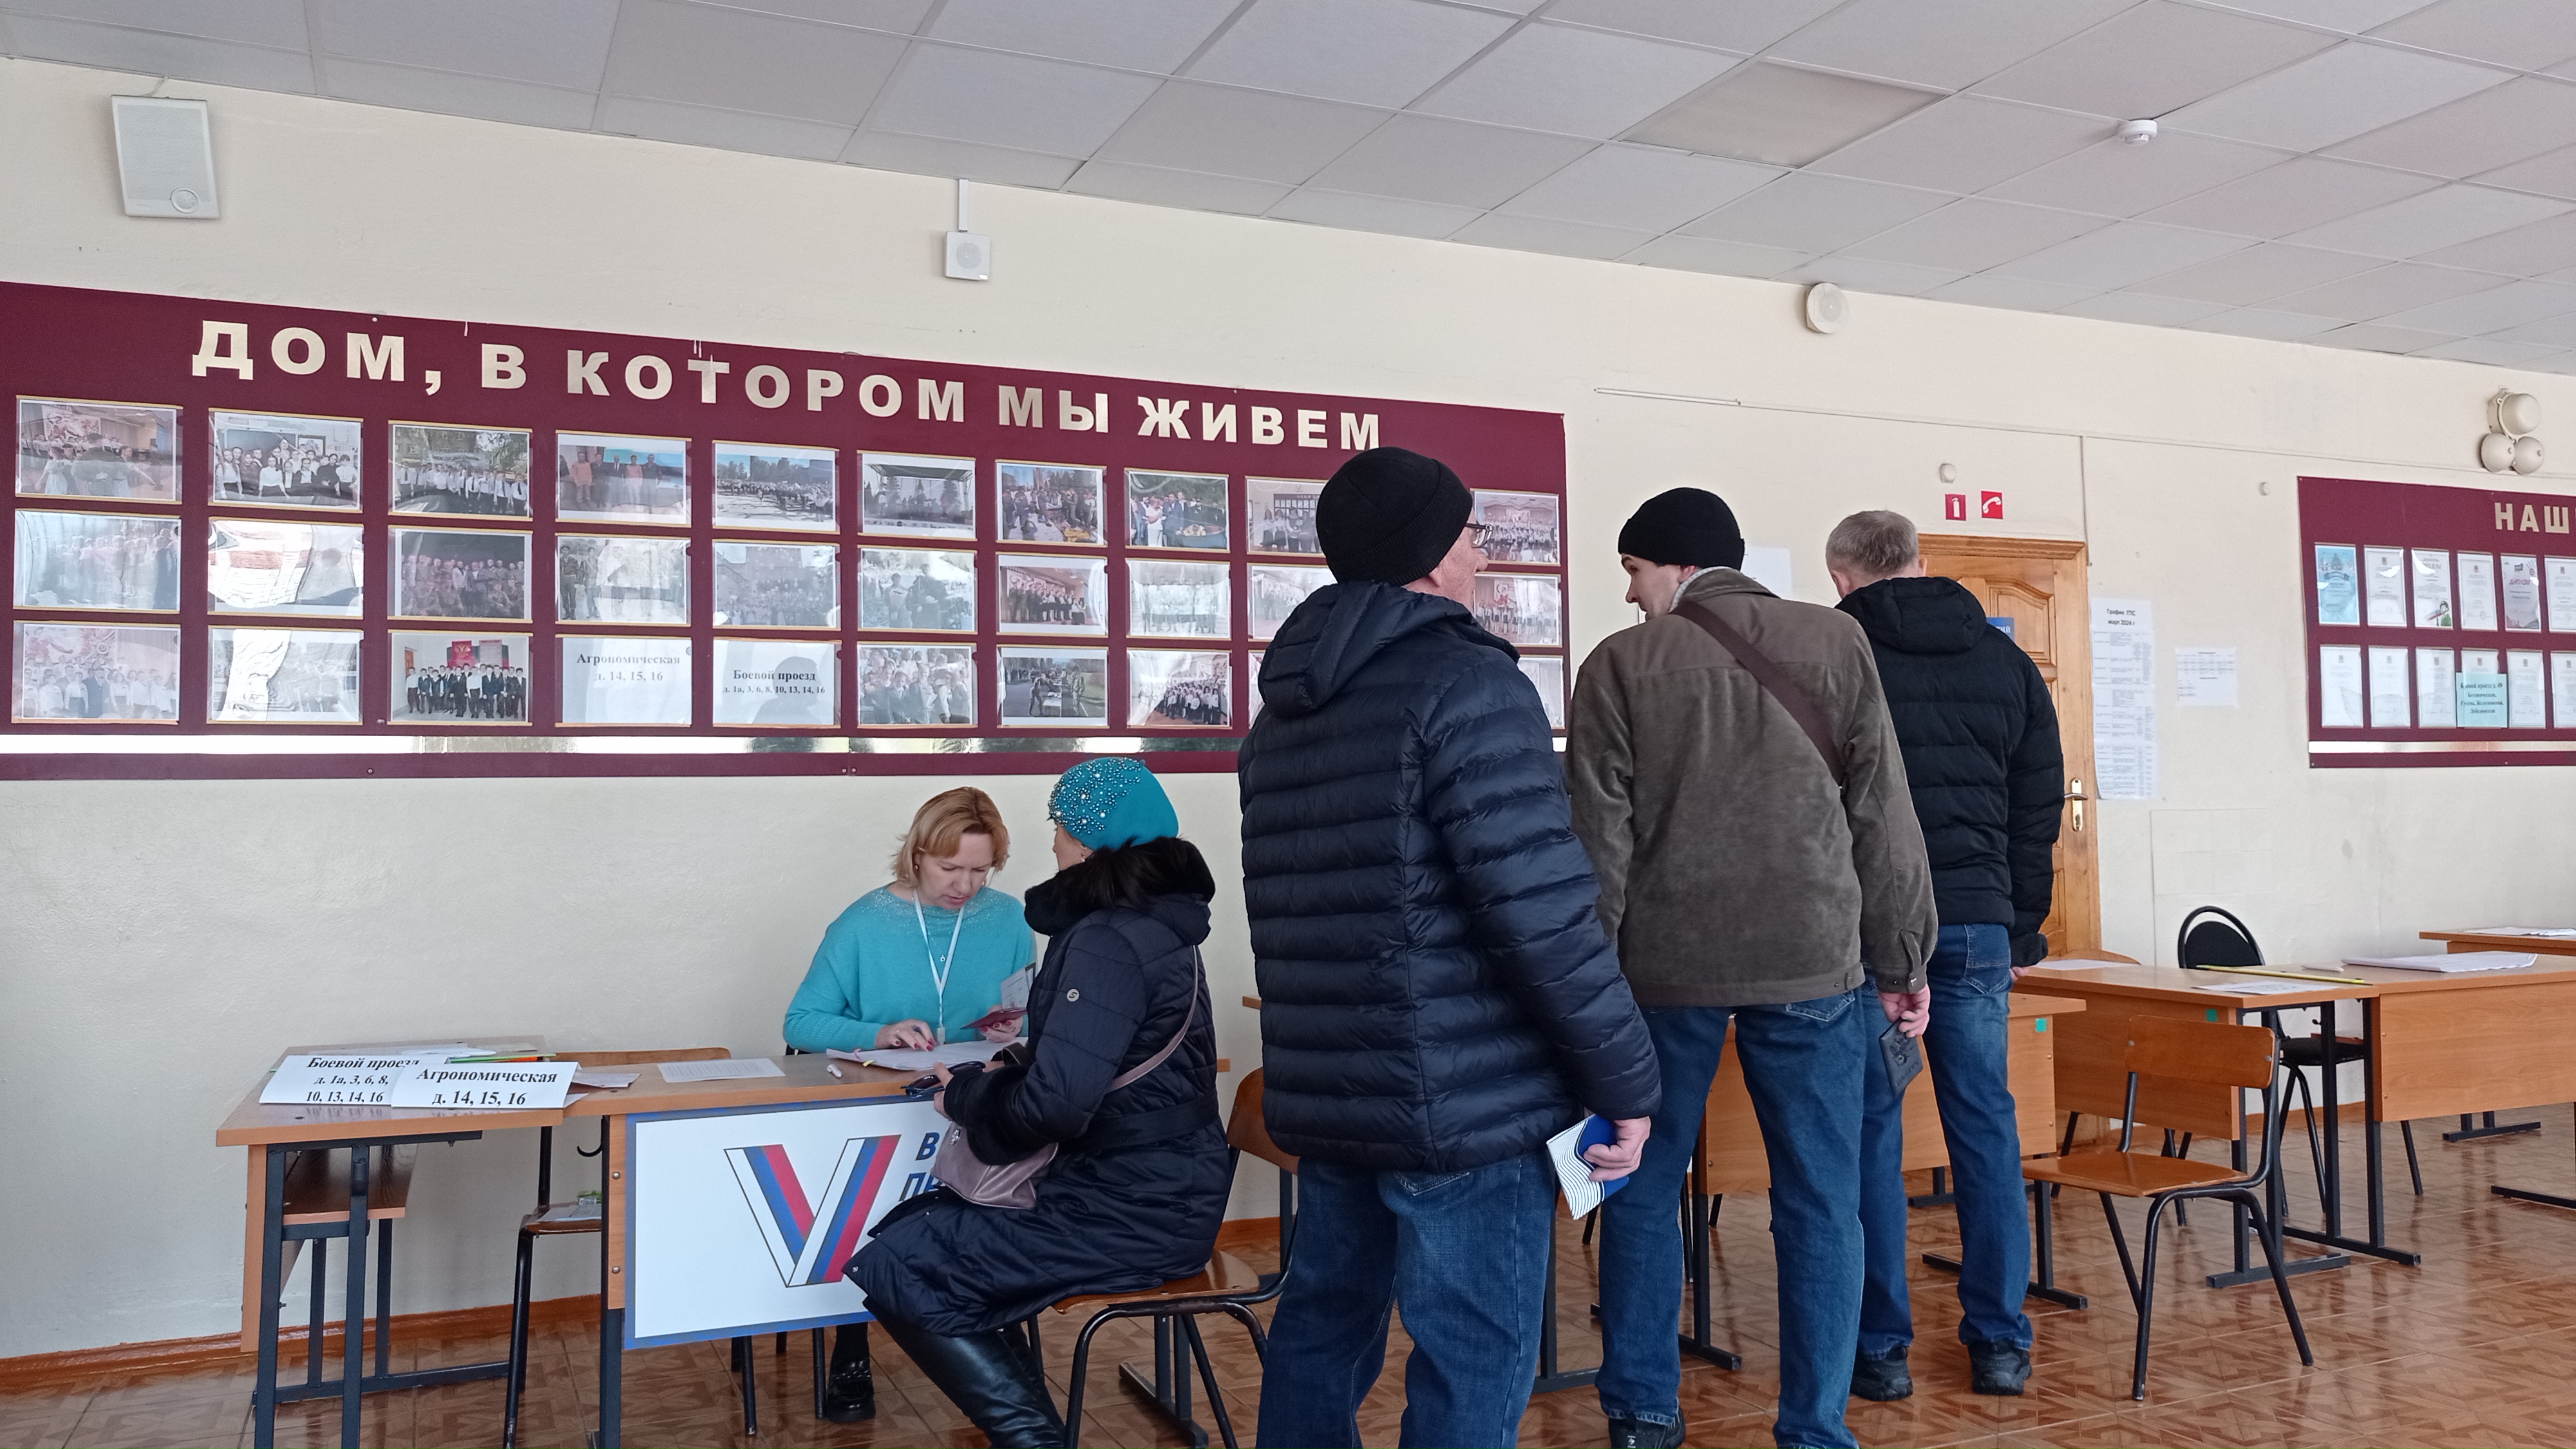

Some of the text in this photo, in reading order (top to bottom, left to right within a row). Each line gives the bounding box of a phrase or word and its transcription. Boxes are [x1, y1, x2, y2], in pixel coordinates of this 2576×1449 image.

[192, 320, 1379, 451] ДОМ, В КОТОРОМ МЫ ЖИВЕМ
[2494, 502, 2576, 534] НАШ
[576, 654, 680, 666] Агрономическая
[611, 671, 626, 683] 14,
[630, 671, 647, 682] 15,
[651, 671, 663, 681] 16
[733, 670, 816, 683] Боевой проезд
[733, 686, 745, 694] 1а,
[756, 686, 764, 694] 6,
[765, 686, 773, 694] 8,
[775, 686, 787, 694] 10,
[789, 686, 800, 694] 13,
[802, 686, 815, 695] 14,
[307, 1057, 365, 1068] Боевой
[330, 1075, 347, 1086] 1а,
[350, 1075, 361, 1086] 3,
[365, 1075, 375, 1086] 6,
[378, 1075, 389, 1086] 8,
[416, 1068, 558, 1083] Агрономическая
[306, 1091, 384, 1104] 10, 13, 14, 16
[431, 1090, 528, 1107] д. 14, 15, 16
